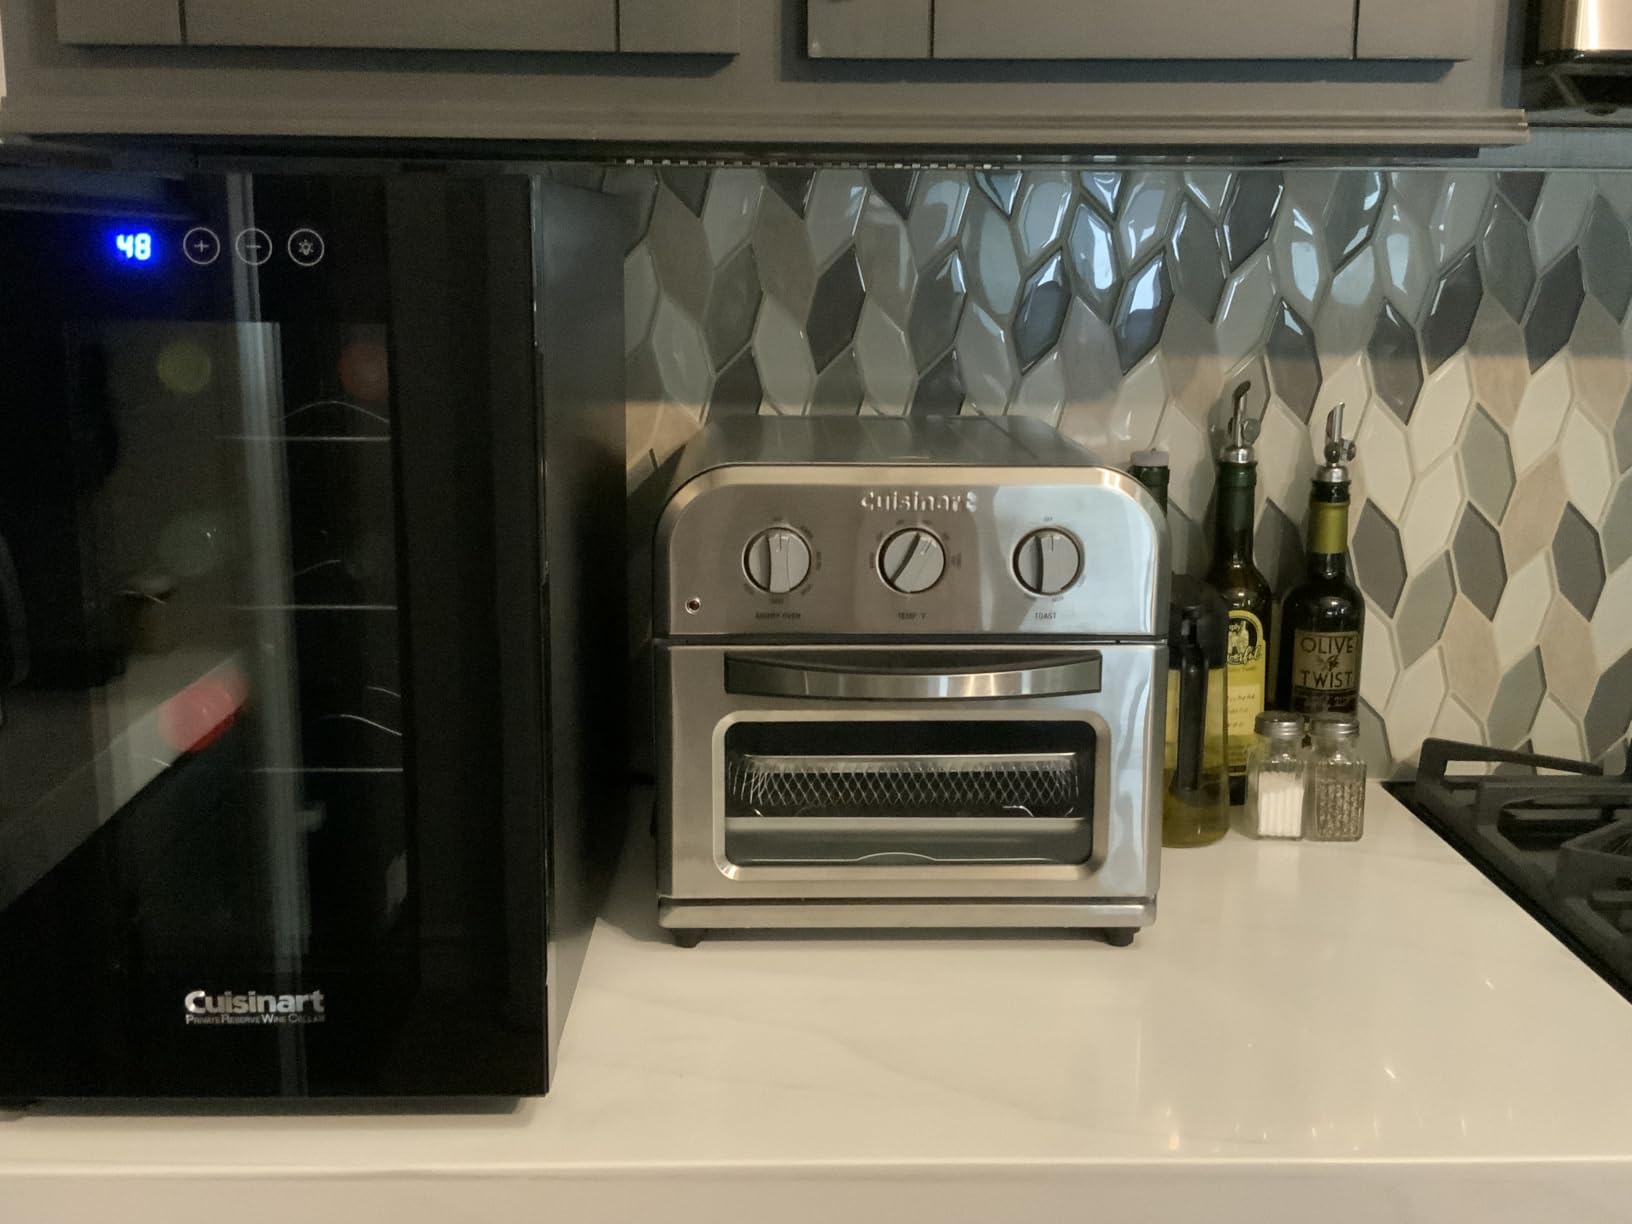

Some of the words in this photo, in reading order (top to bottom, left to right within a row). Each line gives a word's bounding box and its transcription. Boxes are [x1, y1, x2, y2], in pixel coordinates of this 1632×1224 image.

[116, 233, 151, 260] 48
[1035, 612, 1057, 620] TOAST
[1300, 636, 1354, 654] OLIVE
[1301, 671, 1353, 688] TWIST
[185, 990, 325, 1014] Cuisinart
